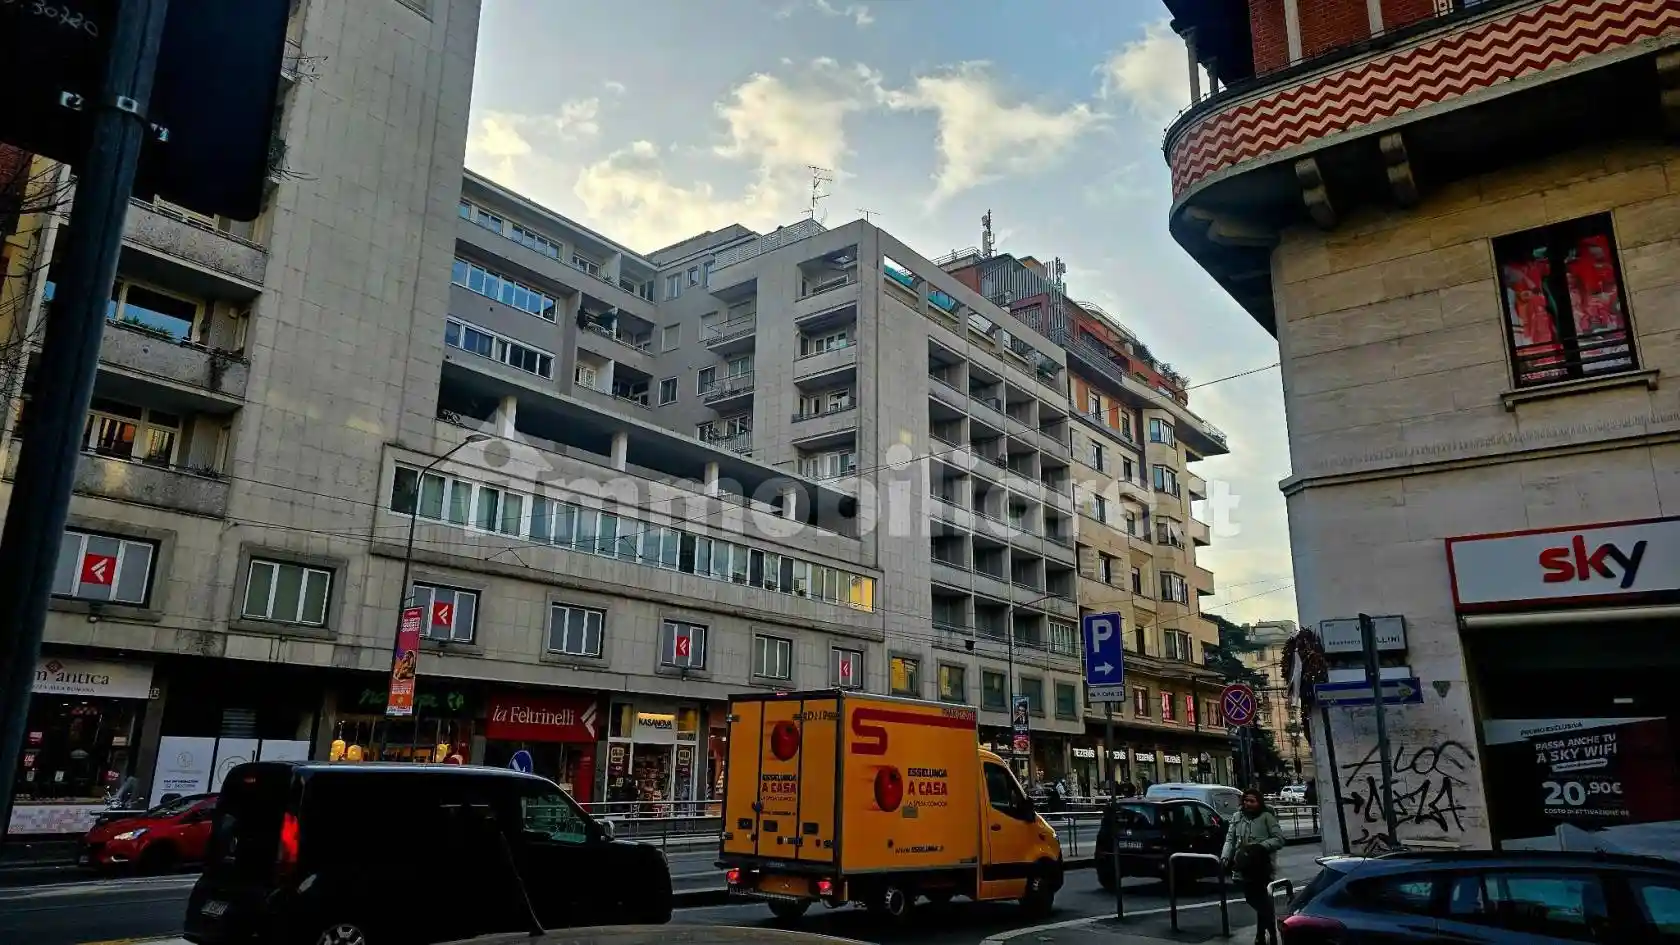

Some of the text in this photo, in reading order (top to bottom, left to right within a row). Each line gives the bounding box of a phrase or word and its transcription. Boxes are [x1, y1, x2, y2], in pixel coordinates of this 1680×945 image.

[1539, 535, 1648, 589] sky
[1092, 619, 1113, 653] P
[56, 670, 110, 685] antica
[509, 706, 574, 726] Feltrinelli
[1535, 732, 1617, 751] PASSA ANCHE TU
[1550, 749, 1580, 762] SKY
[1584, 742, 1618, 758] WIFI
[918, 782, 948, 796] CASA
